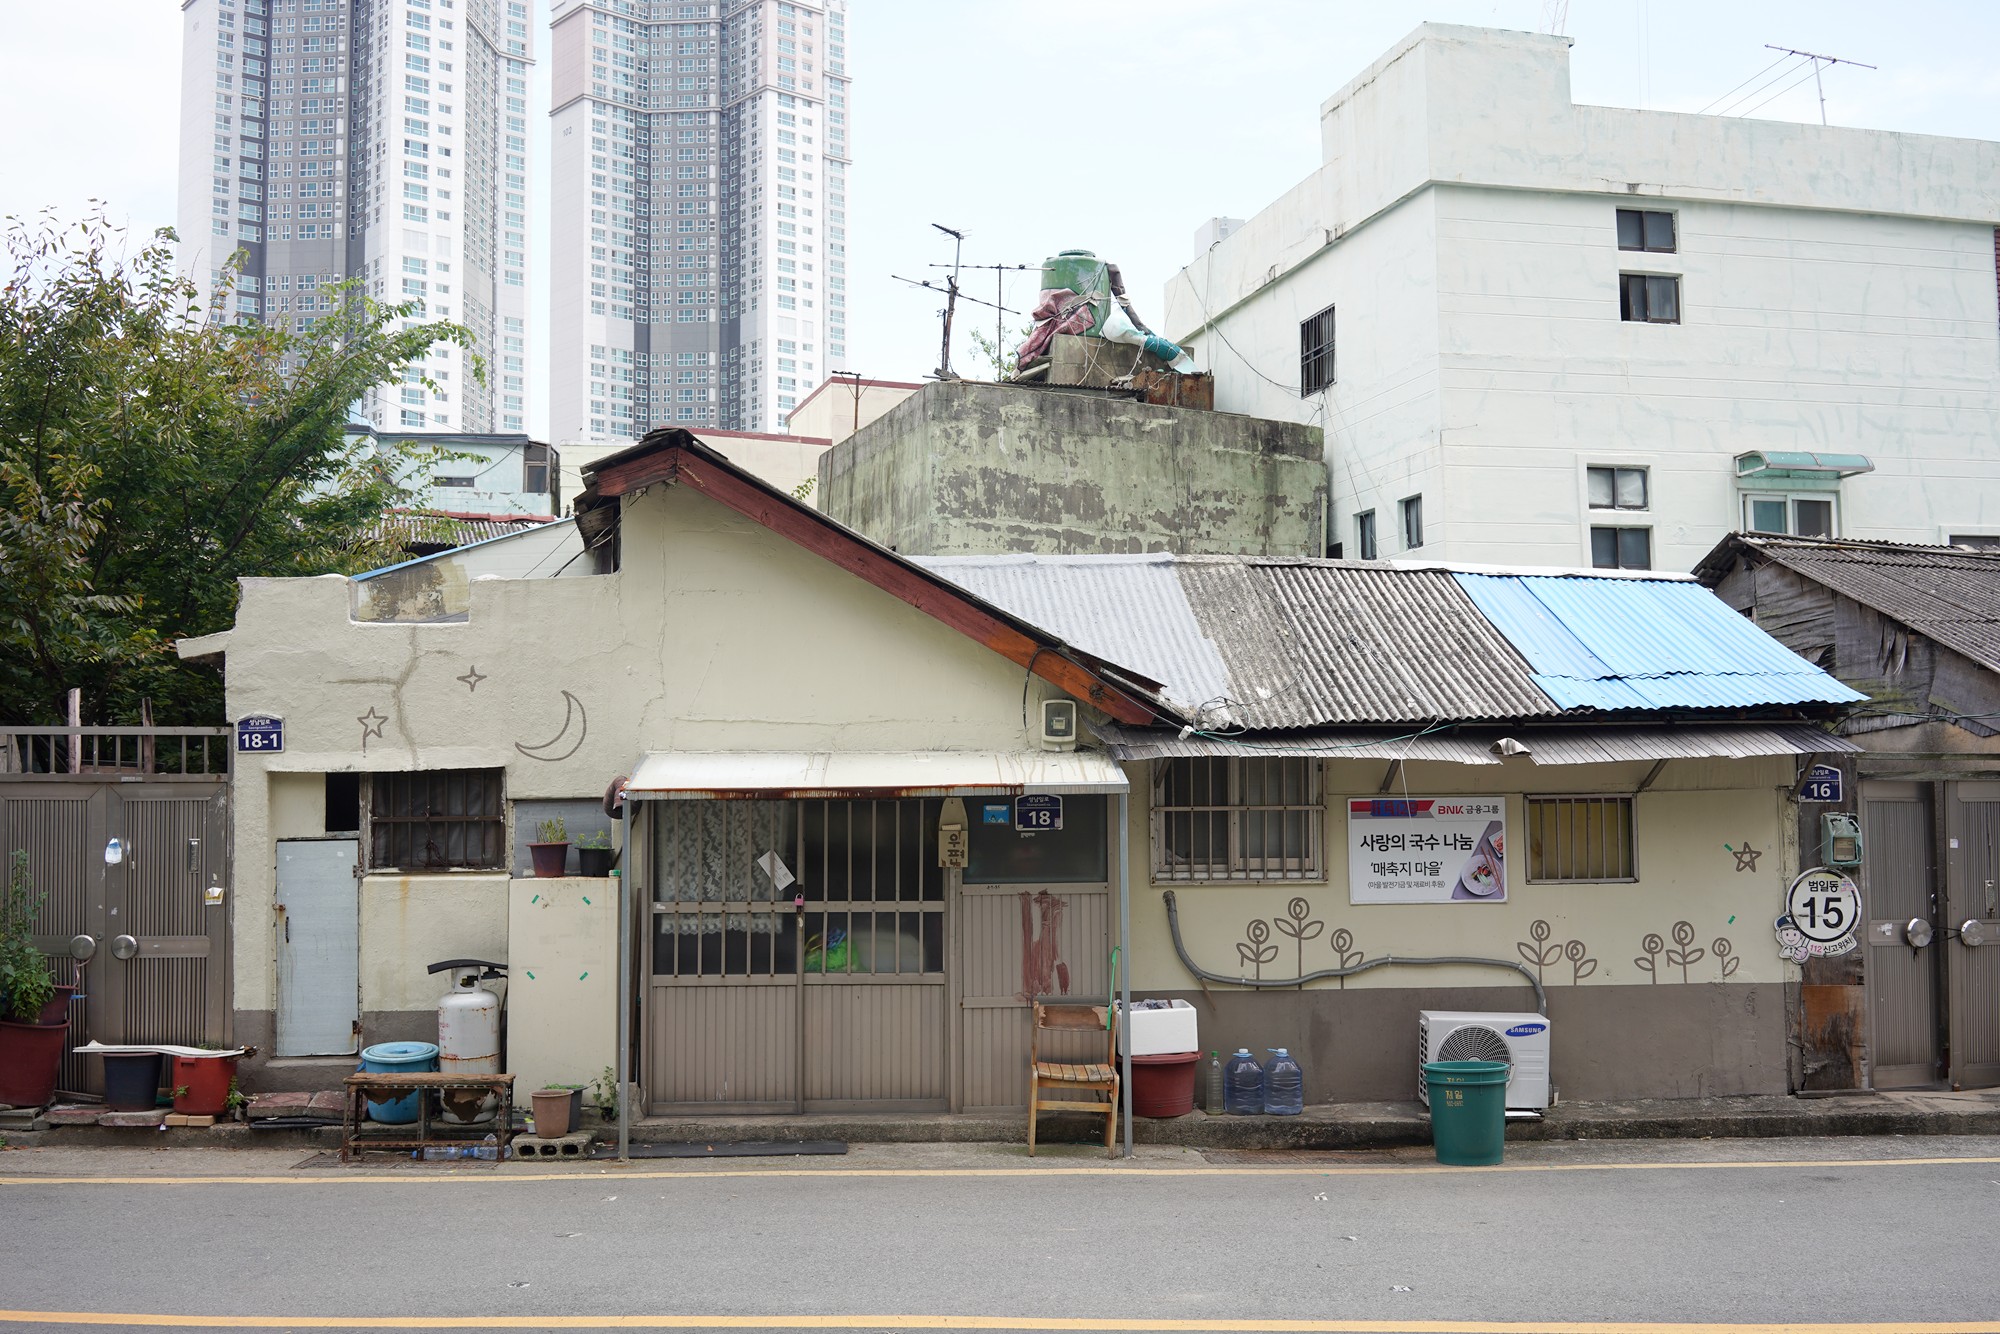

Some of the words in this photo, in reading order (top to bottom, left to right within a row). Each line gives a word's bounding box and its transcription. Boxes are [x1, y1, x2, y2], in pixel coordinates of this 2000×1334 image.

[562, 125, 573, 137] 102
[241, 733, 278, 748] 18-1
[1810, 783, 1831, 798] 16
[1437, 805, 1464, 815] BNK
[1465, 804, 1500, 815] 금융그룹
[1028, 810, 1051, 826] 18
[1360, 833, 1406, 852] 사랑의
[1409, 833, 1441, 851] 국수
[1443, 833, 1474, 851] 나눔
[1808, 880, 1839, 892] 범일동
[1802, 896, 1844, 929] 15
[1810, 944, 1823, 954] 112
[1823, 936, 1853, 954] 신고위치
[1510, 1026, 1542, 1034] SAMSUNG
